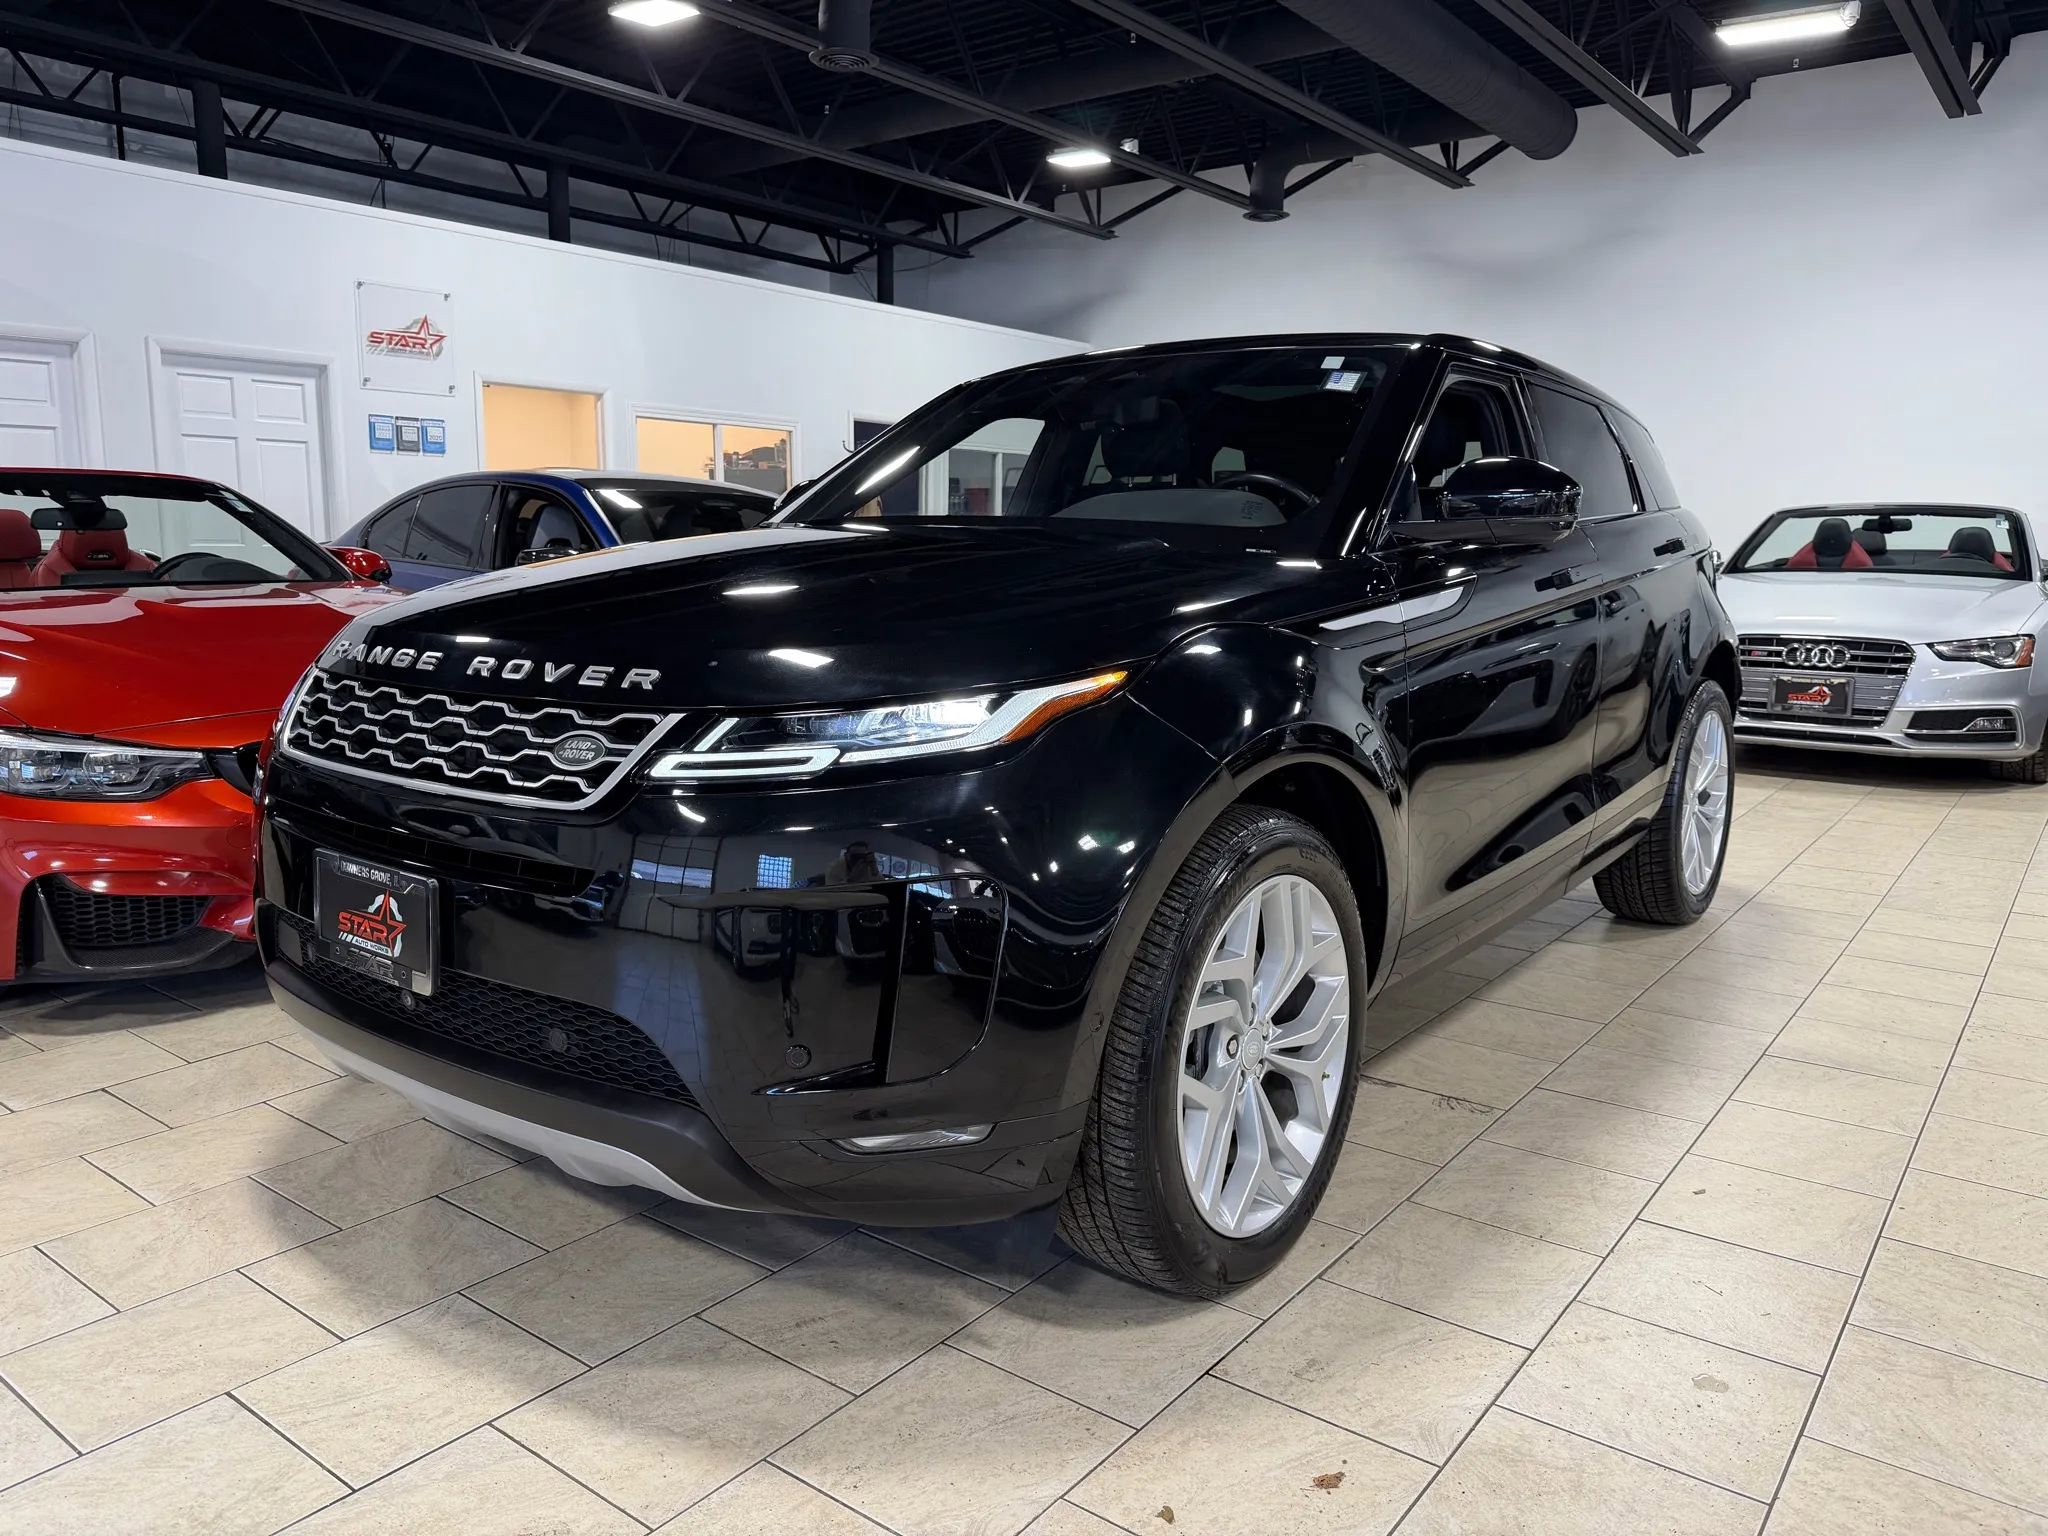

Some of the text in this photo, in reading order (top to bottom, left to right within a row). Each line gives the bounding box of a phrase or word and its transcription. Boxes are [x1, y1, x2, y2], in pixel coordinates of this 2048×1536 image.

[367, 330, 429, 350] STAR
[329, 639, 662, 690] RANGE ROVER
[562, 748, 596, 760] ROVER
[564, 740, 591, 750] LAND
[340, 860, 370, 879] DOWNERS
[337, 911, 388, 945] STAR
[355, 937, 389, 954] AUTO WORKS
